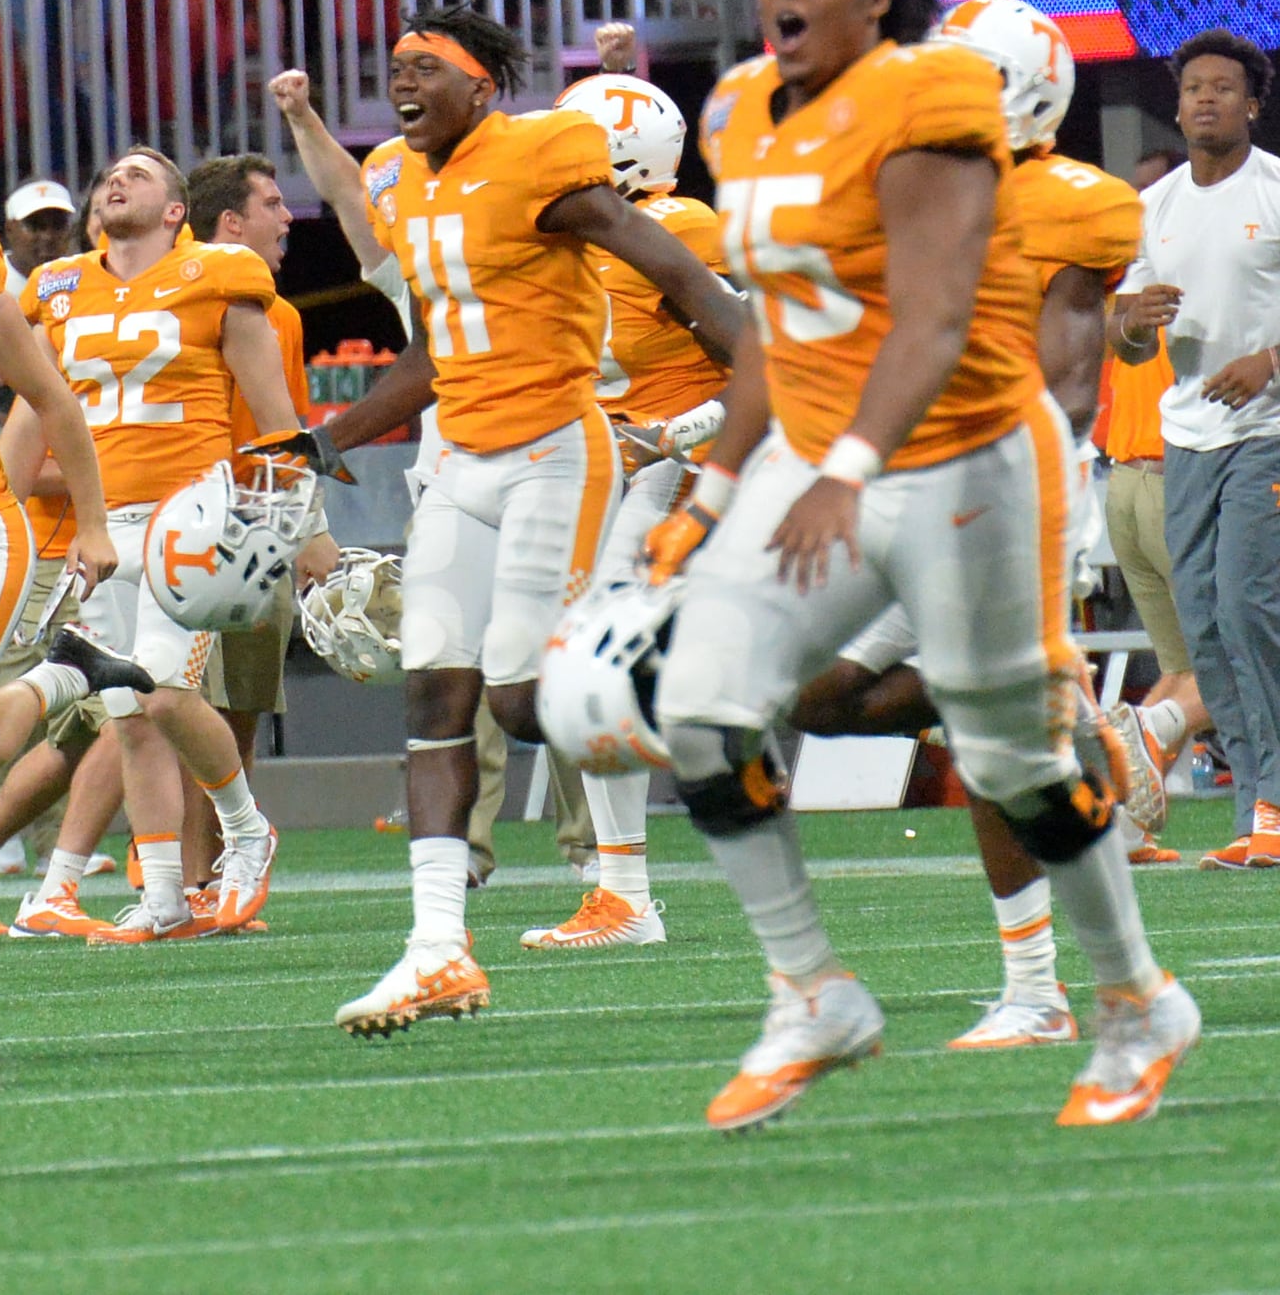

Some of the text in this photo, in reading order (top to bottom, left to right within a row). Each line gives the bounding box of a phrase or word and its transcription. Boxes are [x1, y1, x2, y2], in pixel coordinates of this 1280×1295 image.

[605, 88, 653, 136] T
[424, 180, 440, 201] T
[1244, 223, 1260, 240] T
[114, 288, 130, 303] T
[406, 213, 492, 357] 11
[61, 309, 185, 426] 52
[163, 529, 217, 587] T
